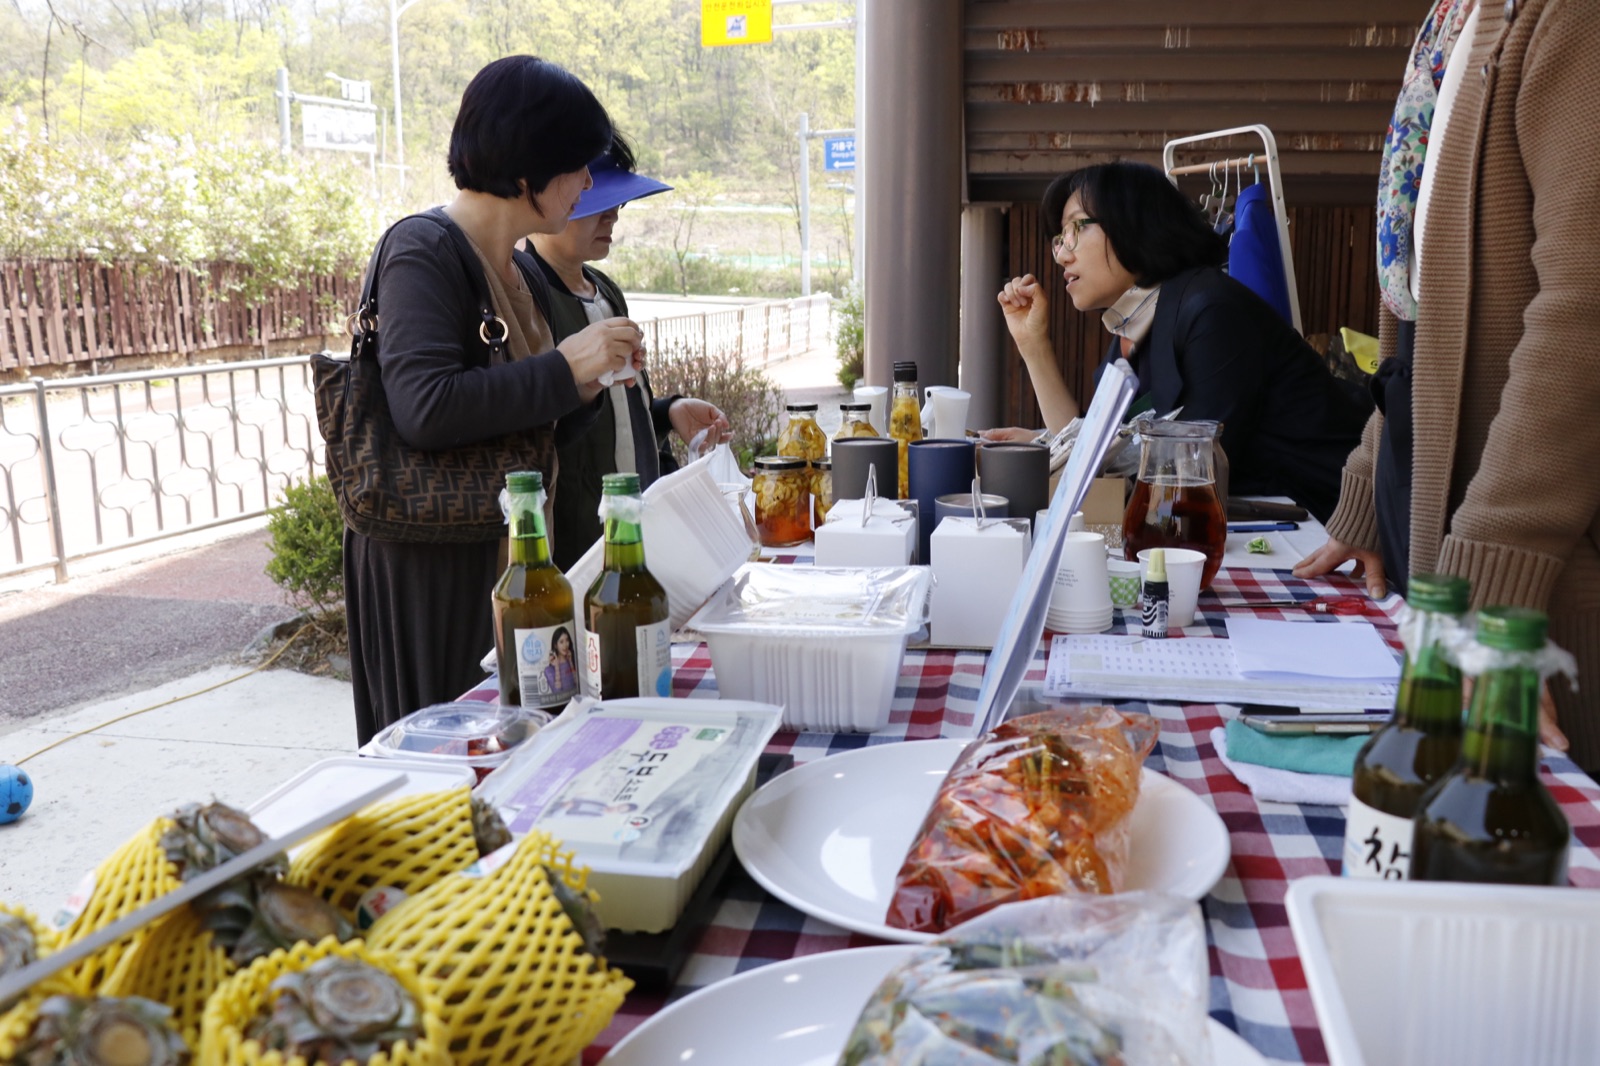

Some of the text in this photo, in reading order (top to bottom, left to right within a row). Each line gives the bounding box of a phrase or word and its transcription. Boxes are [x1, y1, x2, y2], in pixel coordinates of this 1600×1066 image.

[831, 141, 855, 151] 기흥구
[618, 750, 669, 776] 두부
[1364, 826, 1411, 880] 참
